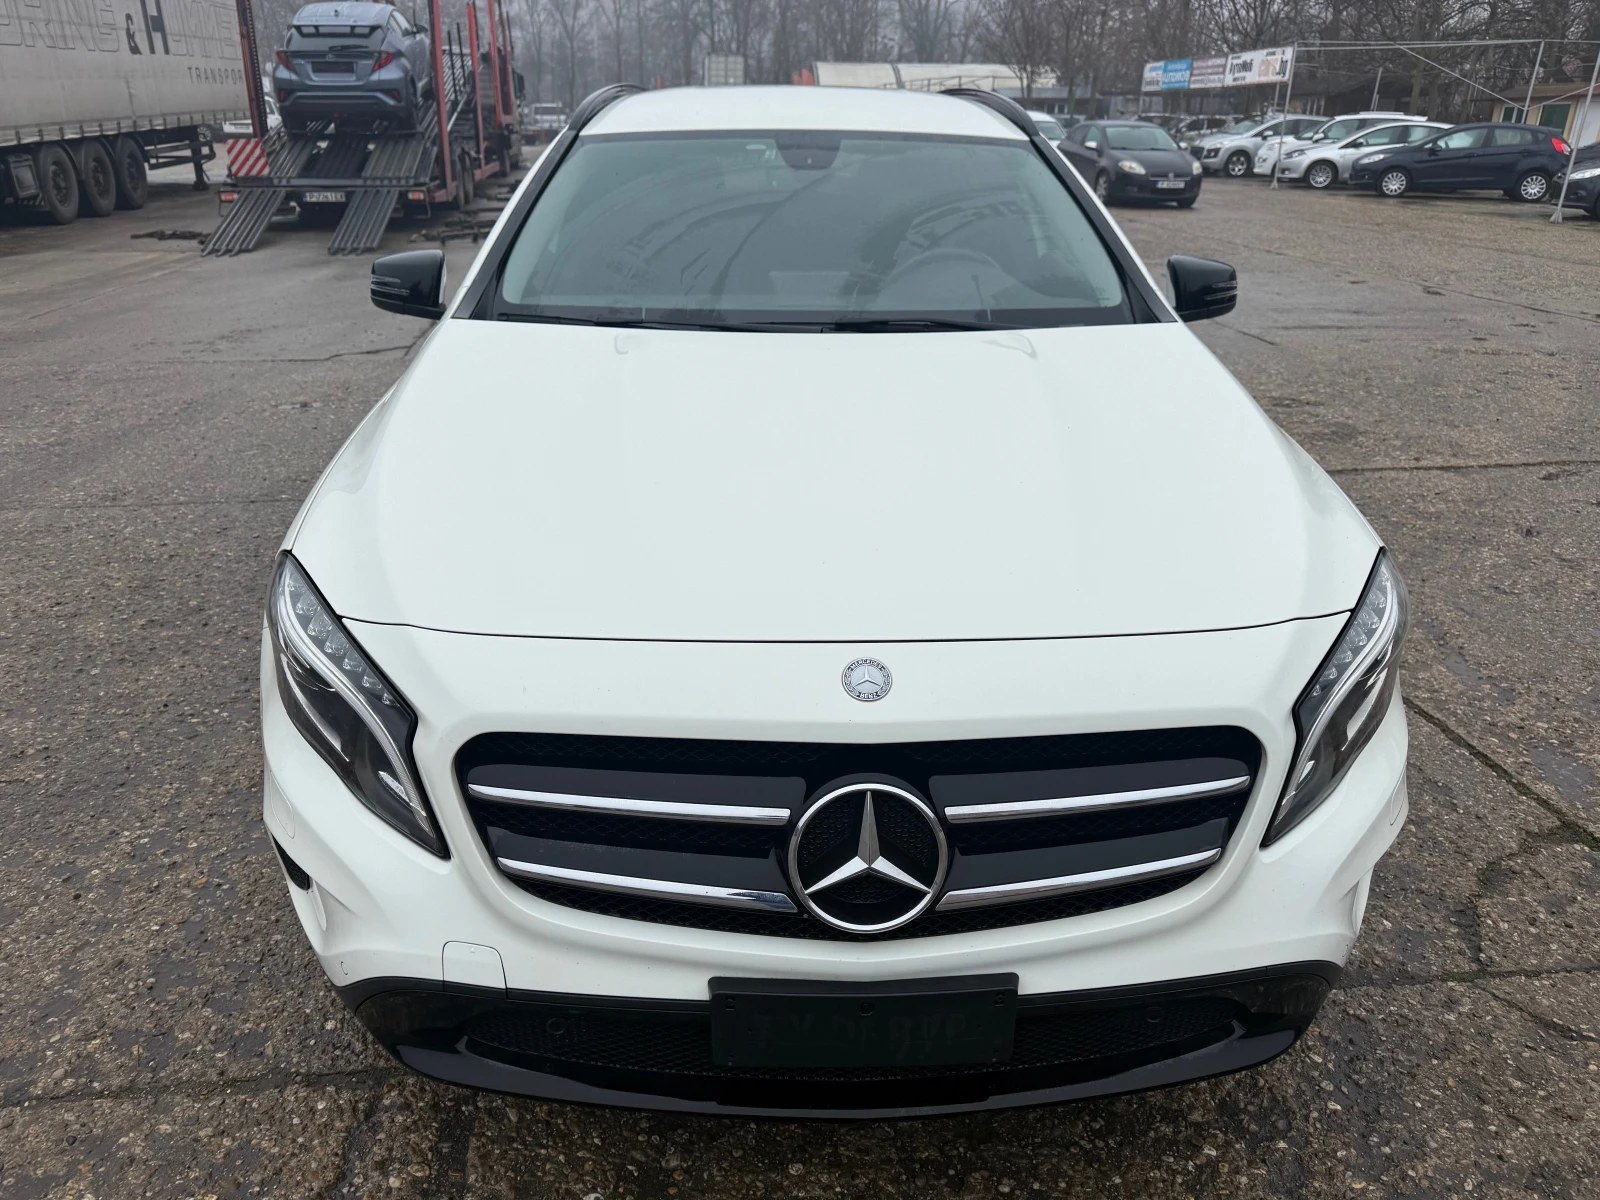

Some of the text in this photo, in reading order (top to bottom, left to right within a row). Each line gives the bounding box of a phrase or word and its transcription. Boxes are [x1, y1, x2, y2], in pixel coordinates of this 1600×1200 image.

[124, 13, 143, 55] &
[846, 658, 887, 672] MERCEDES
[858, 692, 879, 700] BENZ
